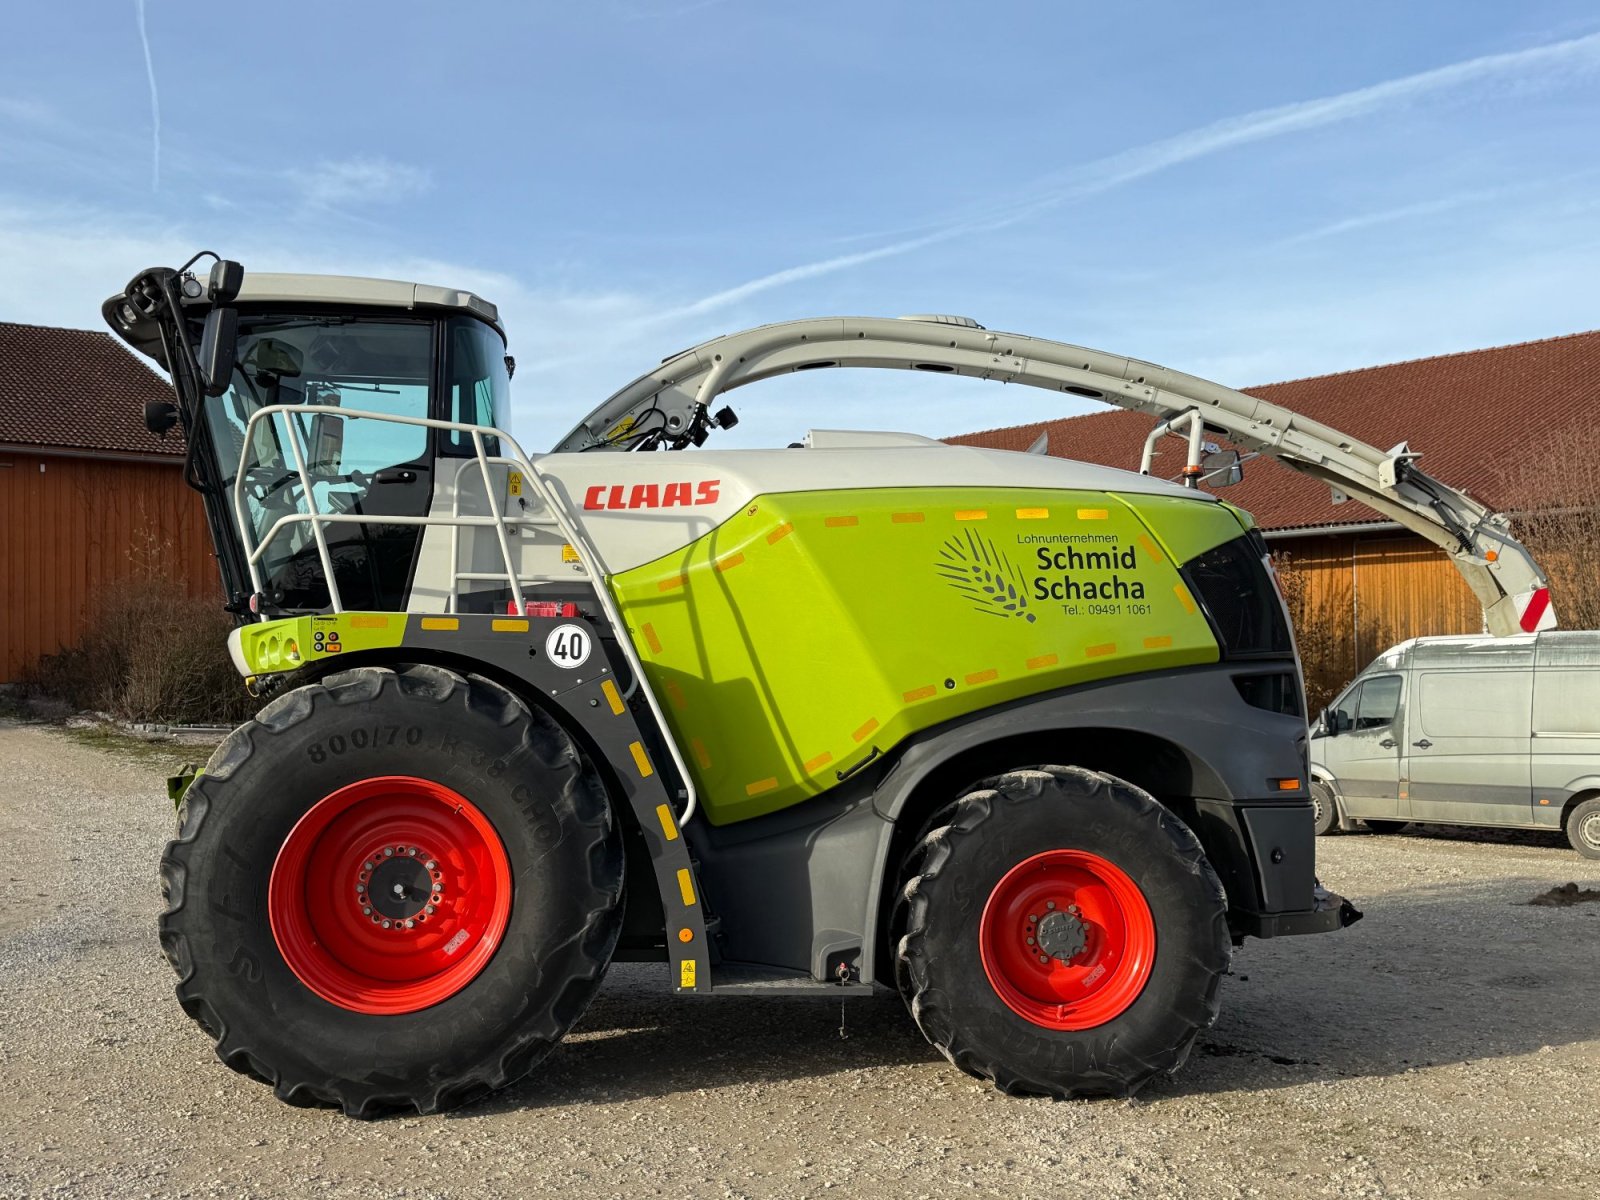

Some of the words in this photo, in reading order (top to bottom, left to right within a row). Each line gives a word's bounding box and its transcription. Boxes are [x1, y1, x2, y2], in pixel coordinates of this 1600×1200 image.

[583, 480, 721, 510] CLAAS
[1017, 534, 1118, 544] Lohnunternehmen
[1037, 545, 1136, 570] Schmid
[1034, 575, 1144, 600] Schacha
[1062, 604, 1085, 615] Tel.:
[1088, 604, 1121, 615] 09491
[1126, 604, 1151, 615] 1061
[553, 632, 583, 660] 40
[306, 725, 424, 764] 800/70
